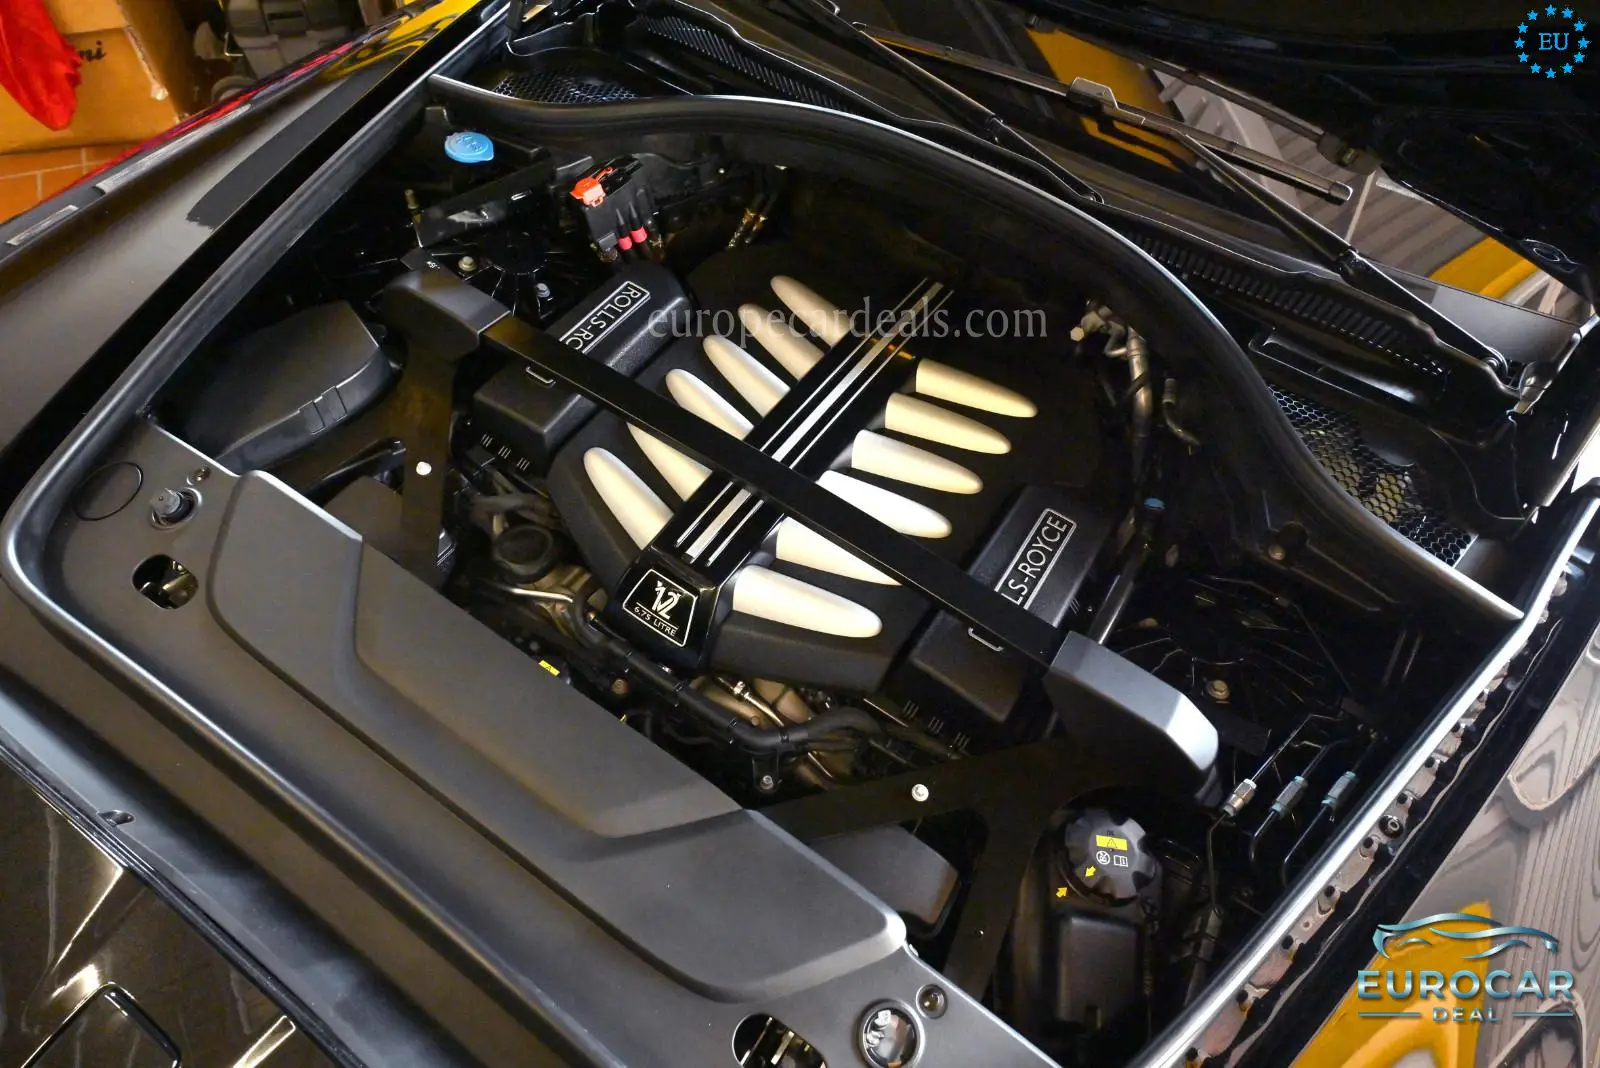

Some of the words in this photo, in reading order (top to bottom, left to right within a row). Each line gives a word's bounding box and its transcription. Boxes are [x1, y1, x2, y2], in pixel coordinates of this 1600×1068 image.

[565, 286, 641, 350] ROLLS-RO
[1001, 516, 1068, 606] LS-ROYCE
[633, 605, 652, 621] 6.75
[653, 618, 678, 637] LITRE
